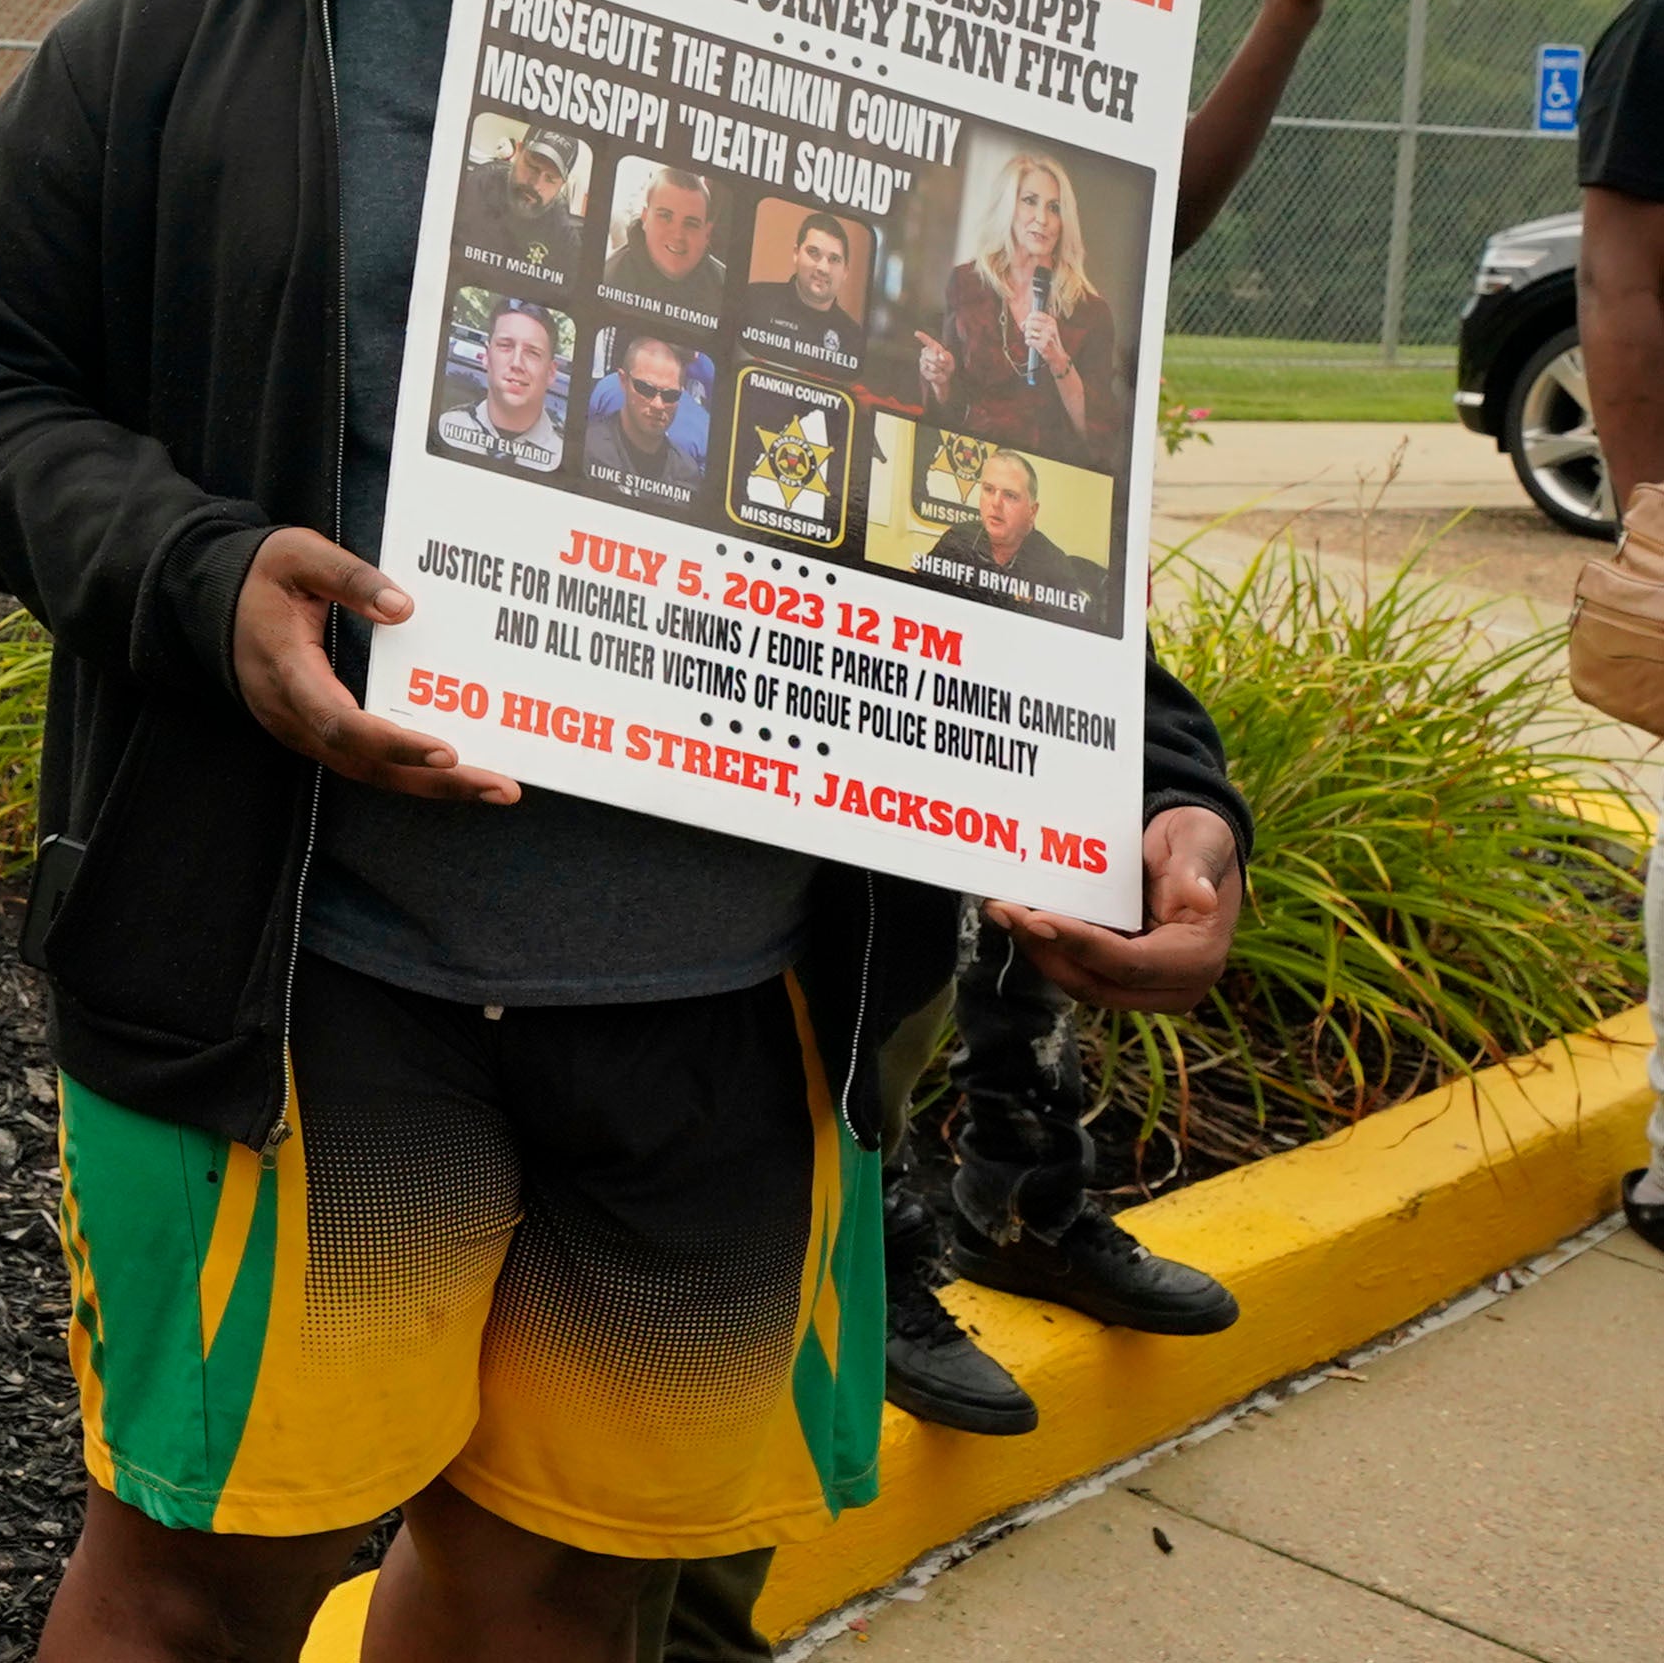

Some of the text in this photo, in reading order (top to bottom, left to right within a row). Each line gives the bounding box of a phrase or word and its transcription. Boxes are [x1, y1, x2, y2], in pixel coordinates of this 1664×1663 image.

[901, 2, 1011, 83] LYNN
[1015, 37, 1138, 123] FITCH
[480, 44, 911, 216] MISSISSIPPI "DEATH SQUAD"
[671, 31, 726, 97] THE
[730, 51, 841, 132] RANKIN
[847, 88, 961, 167] COUNTY
[464, 245, 564, 285] BRETT MCALPIN
[597, 284, 718, 329] CHRISTIAN DEDMON
[742, 326, 858, 370] JOSHUA HARTFIELD
[750, 373, 842, 410] RANKIN COUNTY
[444, 422, 551, 465] HUNTER ELWARD
[591, 464, 622, 484] LUKE
[625, 472, 691, 503] STICKMAN
[740, 504, 832, 542] MISSISSIPPI
[559, 529, 667, 587] JULY
[723, 572, 824, 630] 2023
[836, 602, 880, 644] 12
[891, 616, 963, 666] PM
[911, 551, 1090, 613] SHERIFF BRYAN BAILEY
[418, 538, 1116, 752] JUSTICE FOR MICHAEL JENKINS / EDDIE PARKER / DAMIEN CAMERON
[495, 606, 1039, 778] AND ALL OTHER VICTIMS OF ROGUE POLICE BRUTALITY
[407, 667, 1108, 875] 550 HIGH STREET, JACKSON, MS
